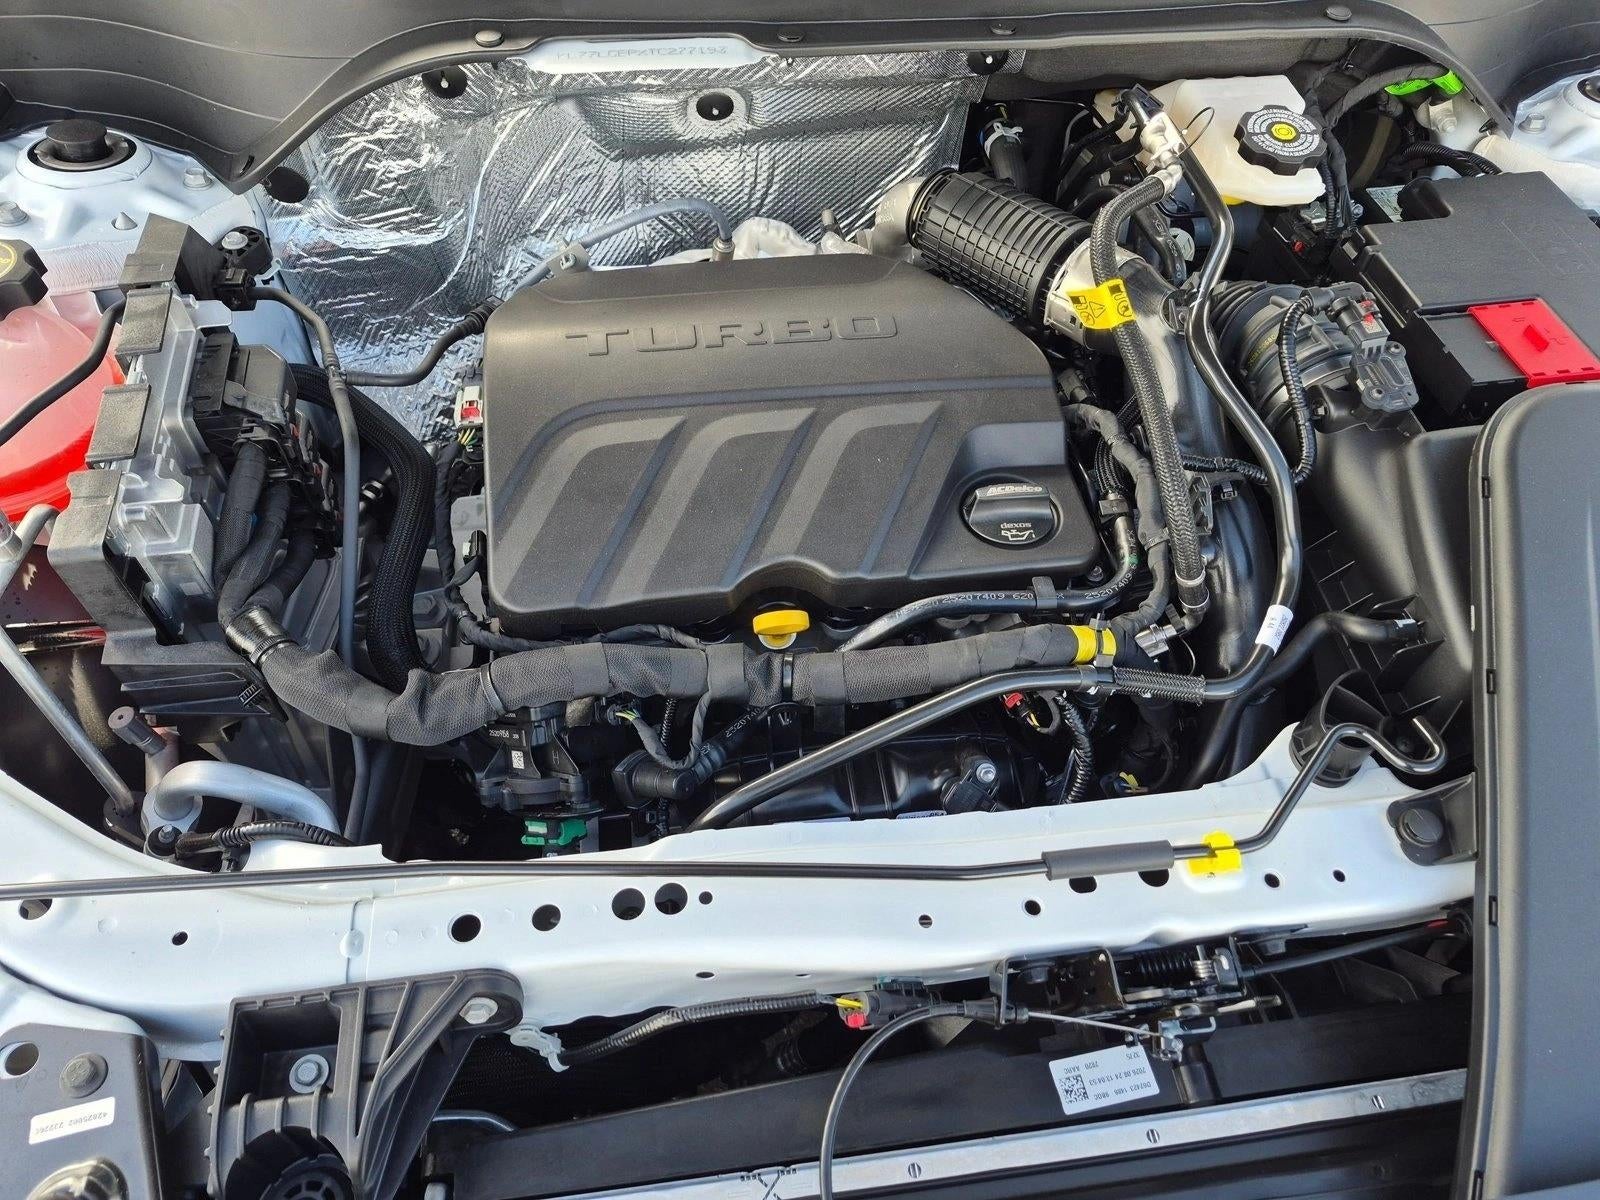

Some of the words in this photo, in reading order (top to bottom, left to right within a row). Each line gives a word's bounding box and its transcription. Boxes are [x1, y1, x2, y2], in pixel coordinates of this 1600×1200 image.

[564, 314, 898, 356] TURBO
[987, 485, 1043, 496] ACDelco
[1084, 572, 1132, 600] 25207409
[943, 593, 1005, 602] 25207409
